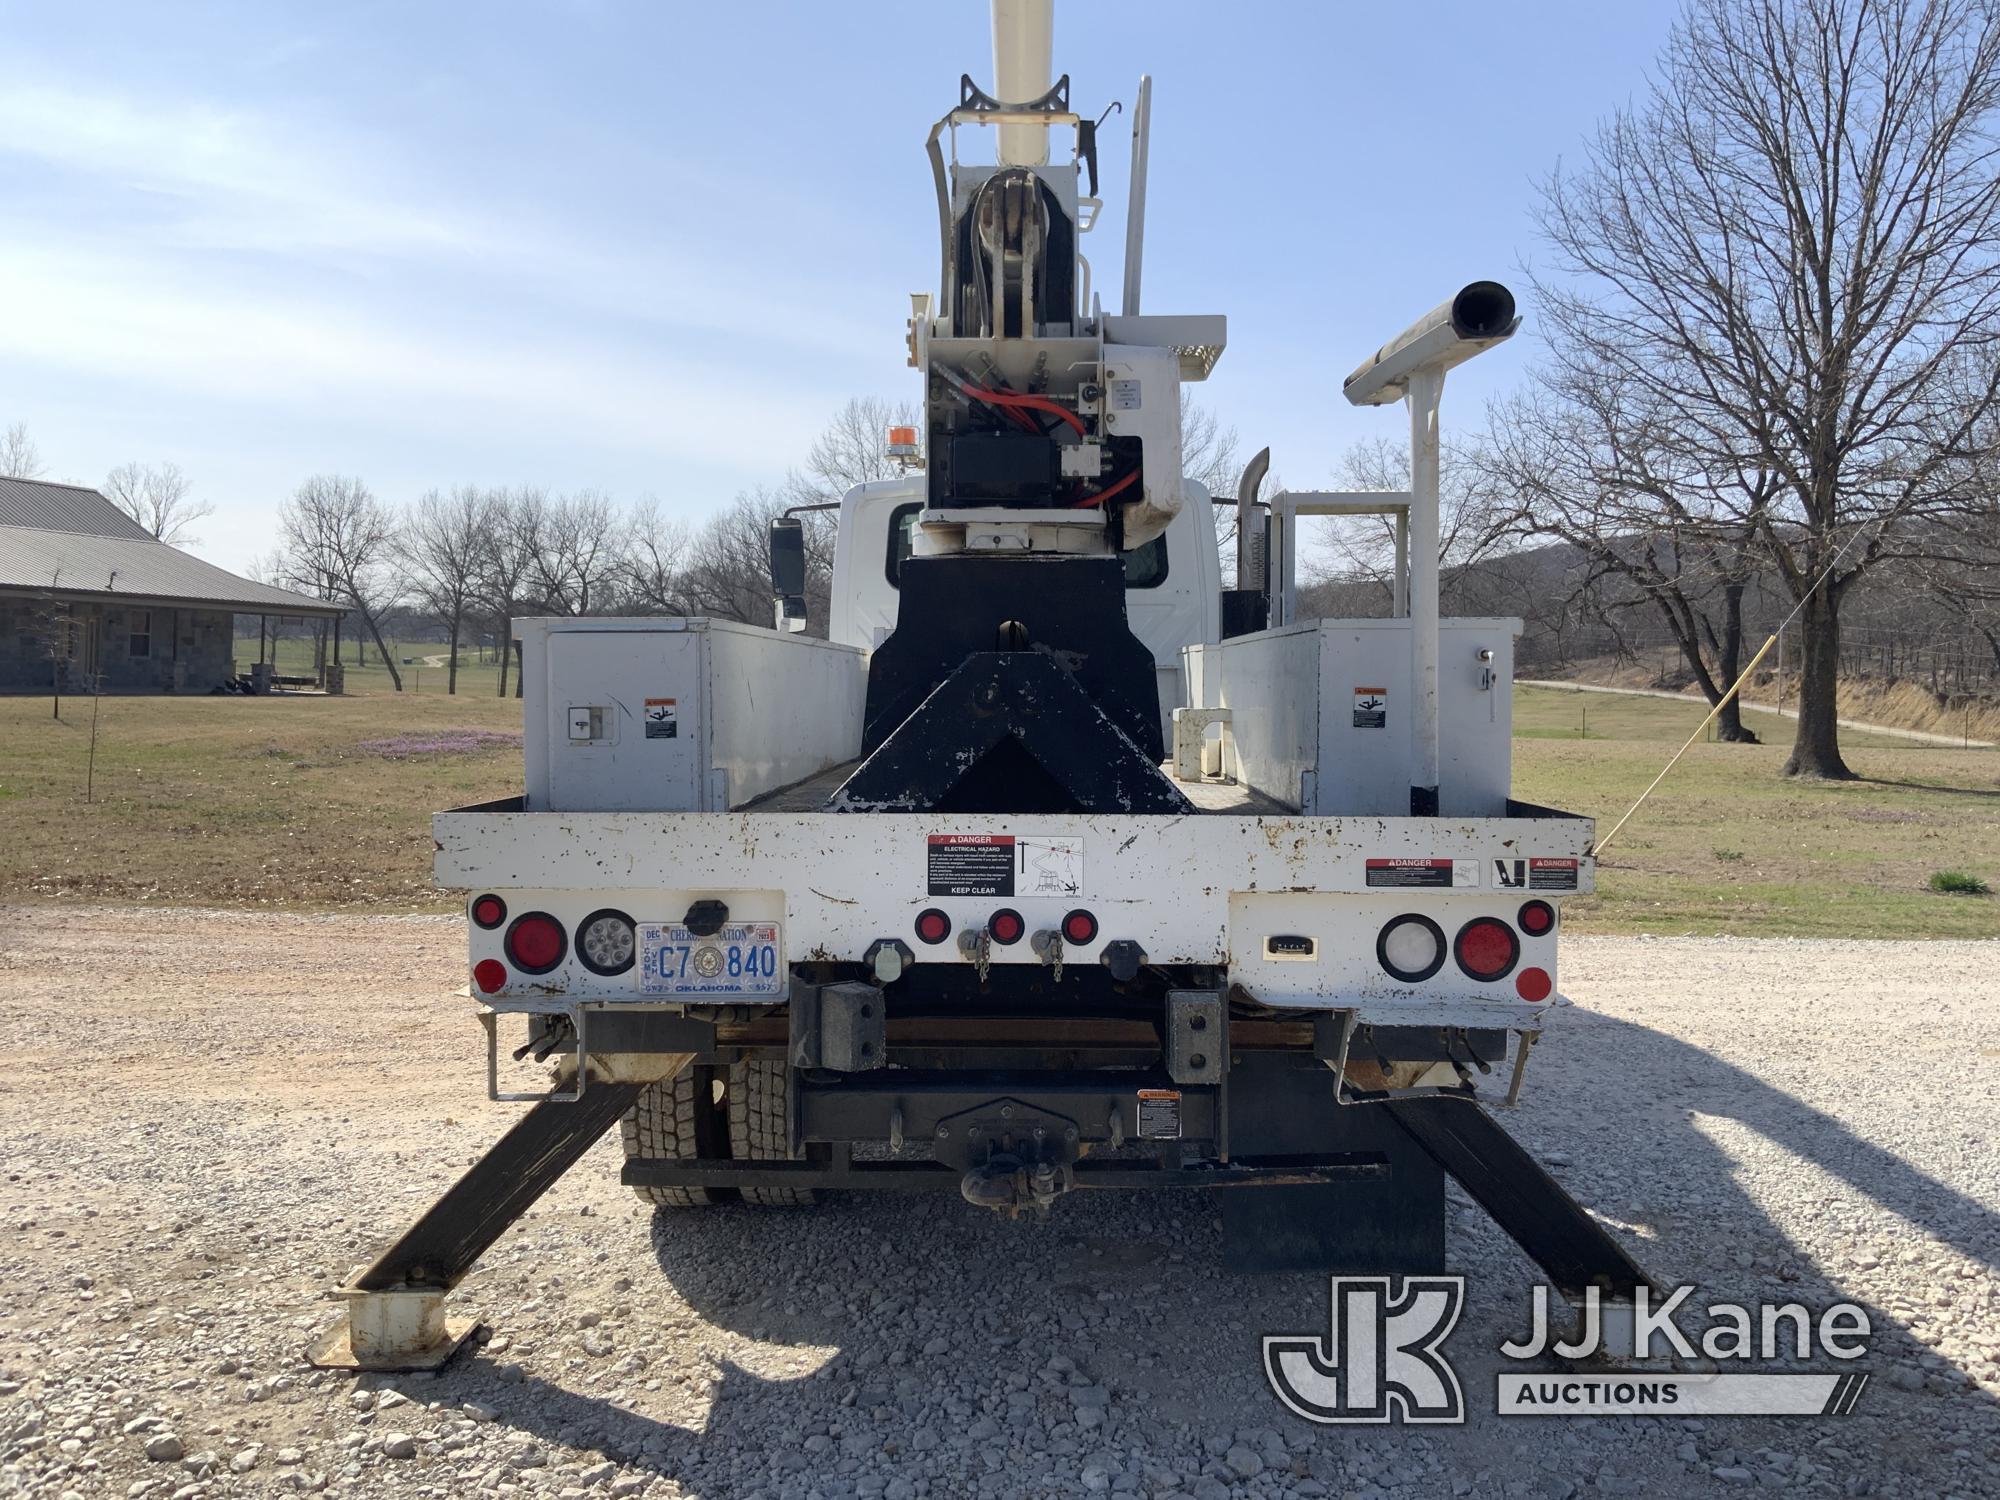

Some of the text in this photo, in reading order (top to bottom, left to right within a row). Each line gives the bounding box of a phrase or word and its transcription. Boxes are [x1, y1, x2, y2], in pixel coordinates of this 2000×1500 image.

[1395, 859, 1432, 867] DANGER
[646, 930, 661, 939] DEC
[660, 945, 775, 978] C7 840
[675, 984, 742, 992] OKLAHOMA
